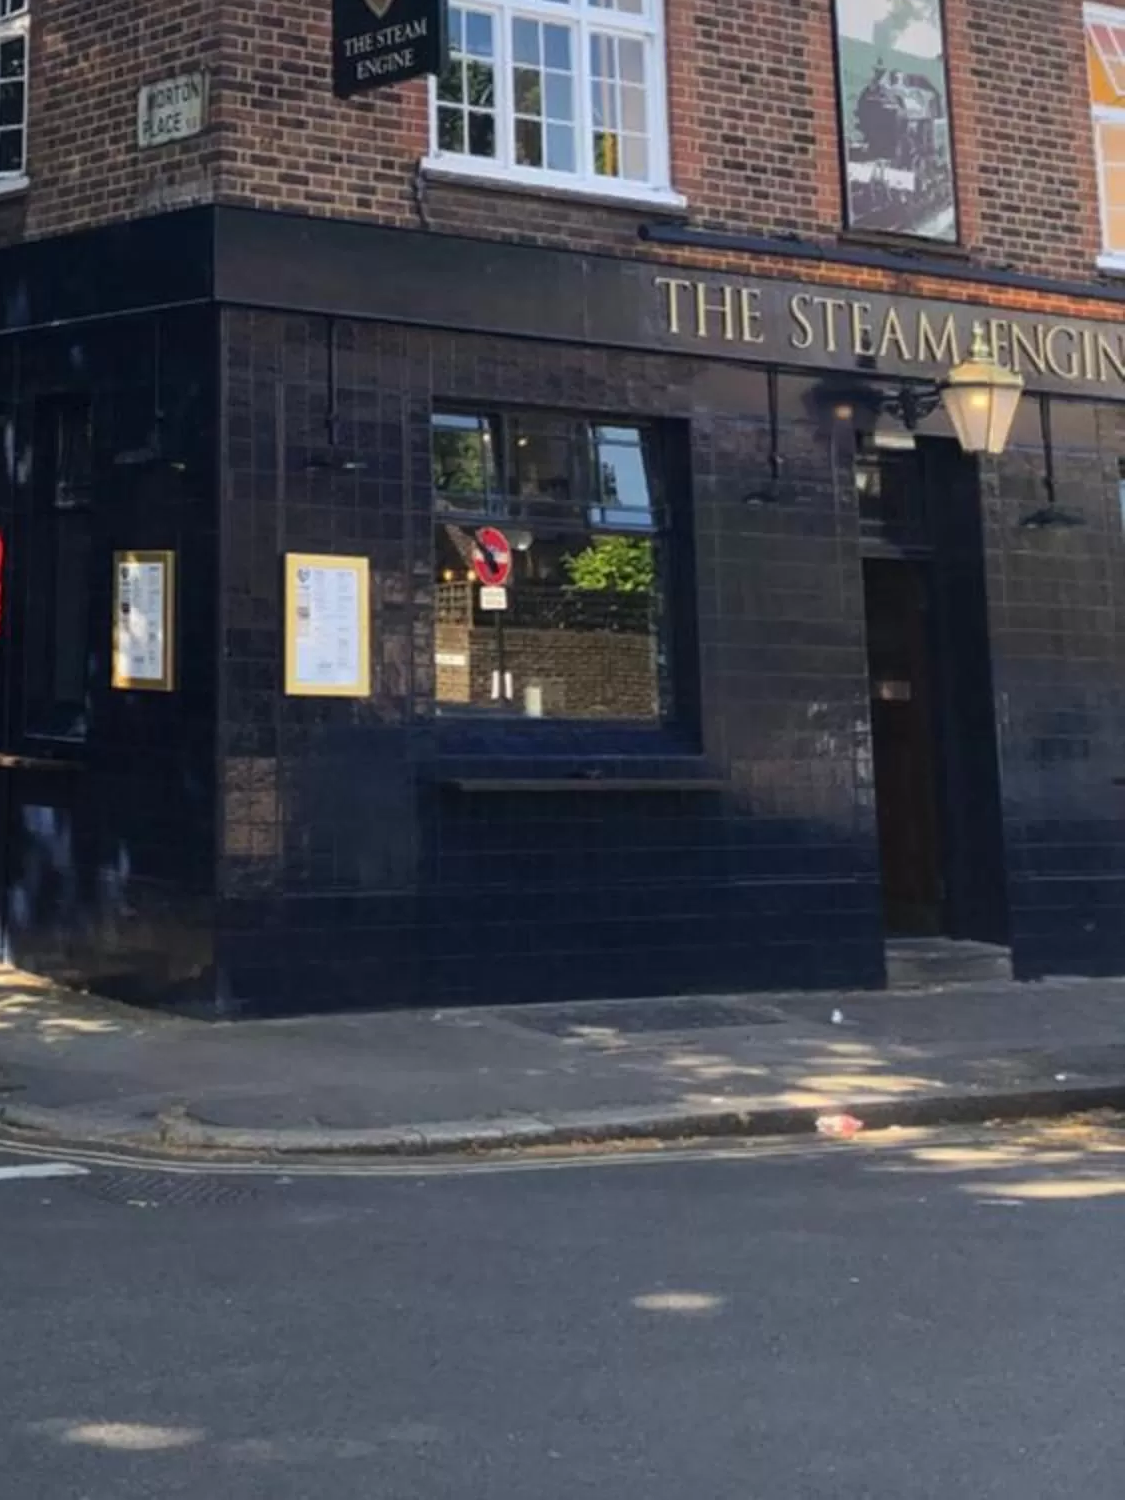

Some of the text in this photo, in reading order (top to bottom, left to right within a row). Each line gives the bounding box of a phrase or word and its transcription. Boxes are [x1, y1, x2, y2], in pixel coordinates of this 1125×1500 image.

[344, 17, 428, 57] THE STEAM
[356, 48, 415, 81] ENGINE
[142, 112, 182, 141] PLACE
[654, 275, 764, 344] THE
[789, 293, 961, 365] STEAM
